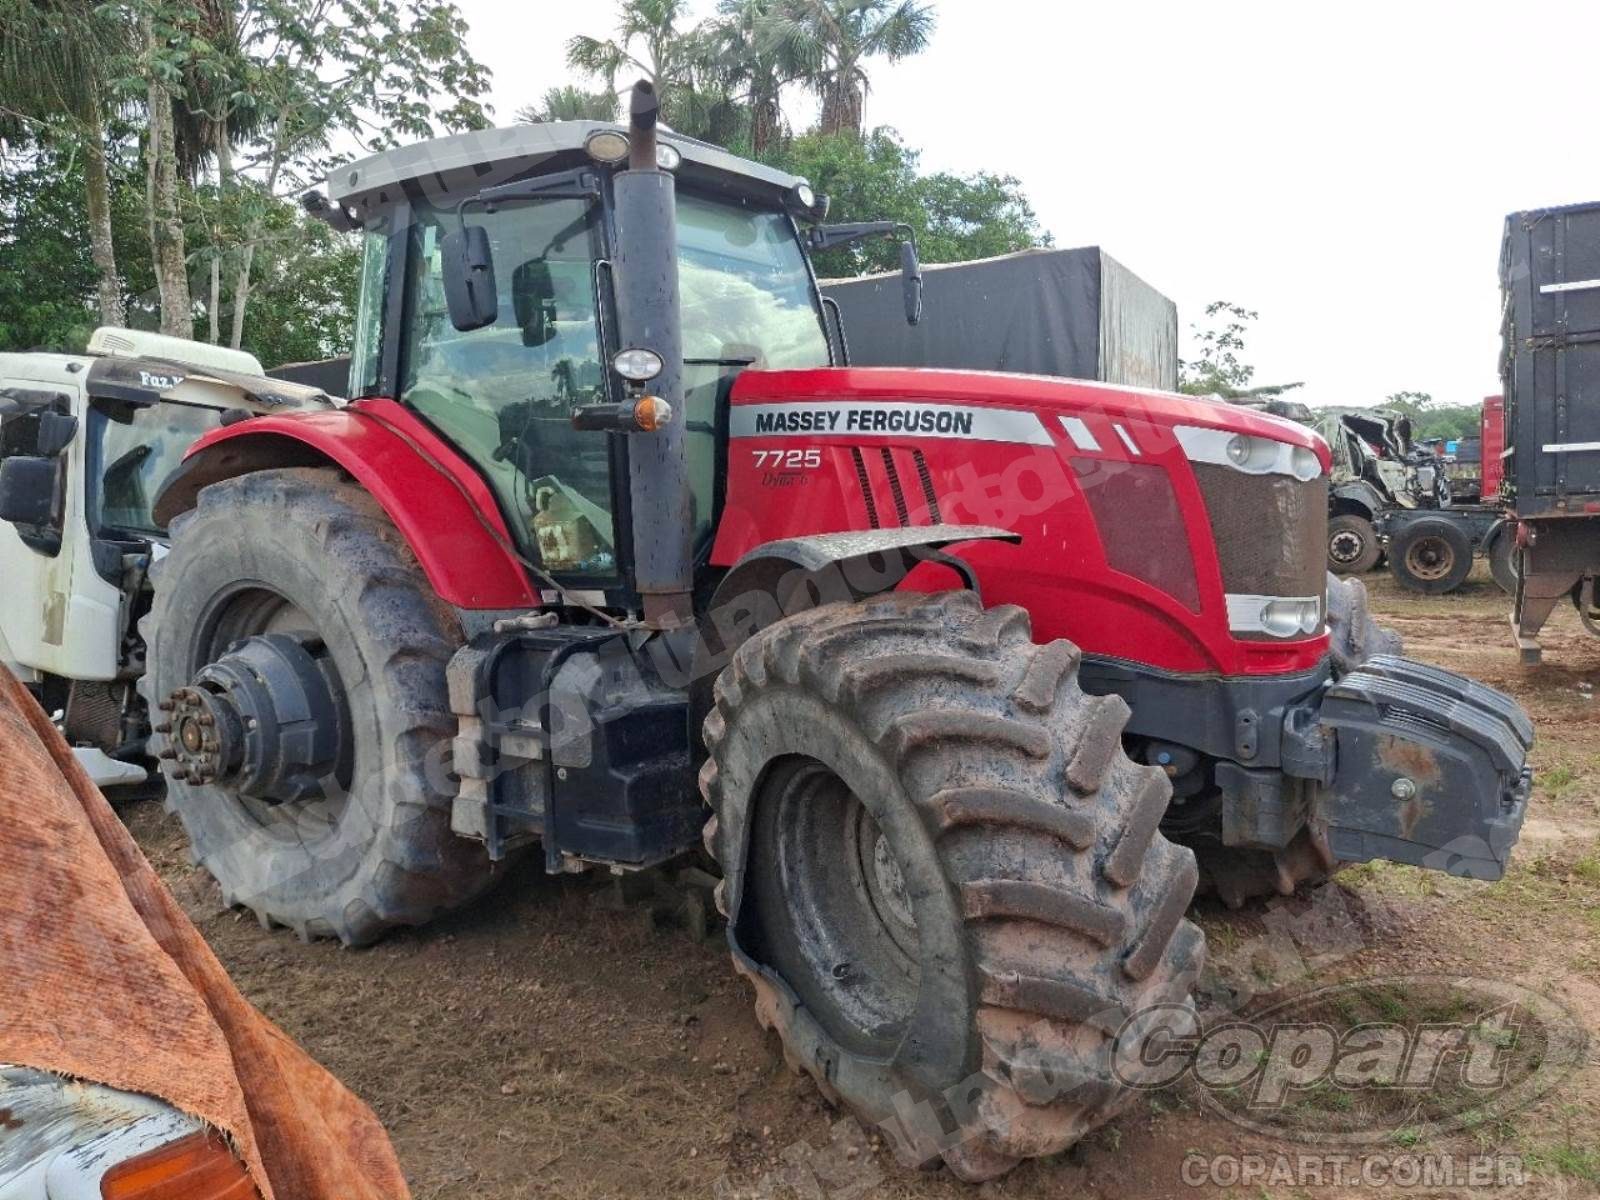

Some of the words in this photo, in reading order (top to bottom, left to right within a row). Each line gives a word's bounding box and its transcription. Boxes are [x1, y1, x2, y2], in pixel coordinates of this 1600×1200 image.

[755, 409, 839, 433] MASSEY
[847, 409, 973, 434] FERGUSON
[752, 449, 821, 468] 7725
